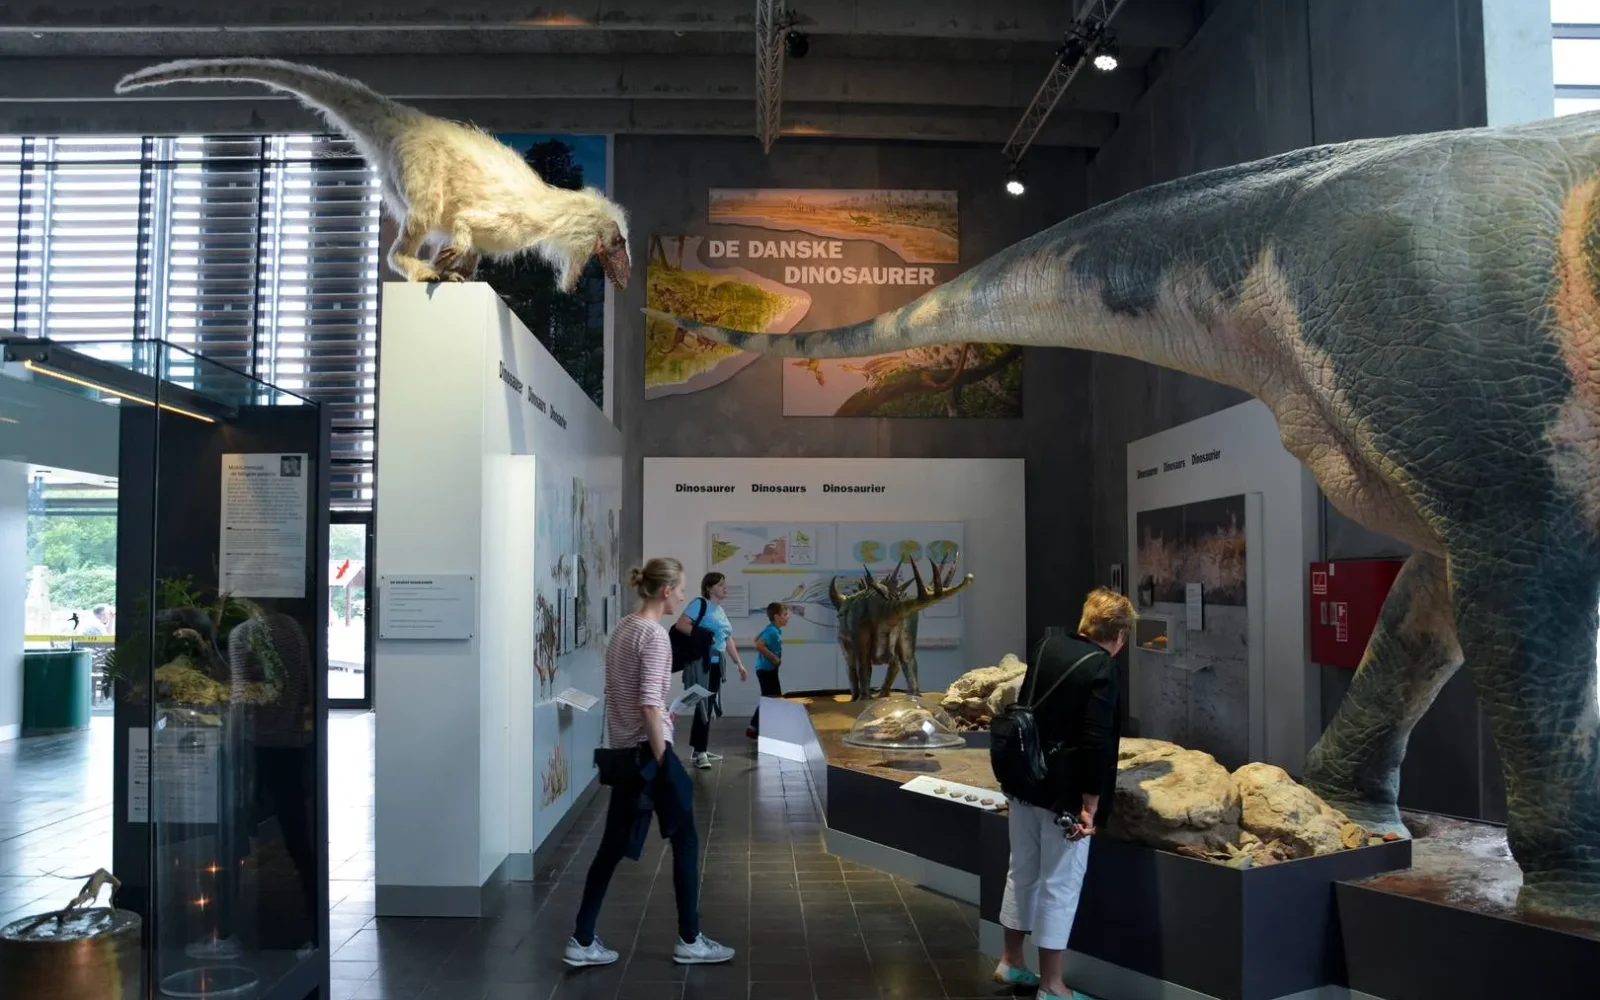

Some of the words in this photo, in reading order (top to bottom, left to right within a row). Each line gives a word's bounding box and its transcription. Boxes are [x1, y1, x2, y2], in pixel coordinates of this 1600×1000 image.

[709, 240, 740, 258] DE
[748, 240, 844, 259] DANSKE
[785, 266, 936, 285] DINOSAURER
[1191, 449, 1221, 466] Dinosaurier
[675, 483, 735, 493] Dinosaurer
[751, 483, 807, 493] Dinosaurs
[822, 483, 886, 493] Dinosaurier
